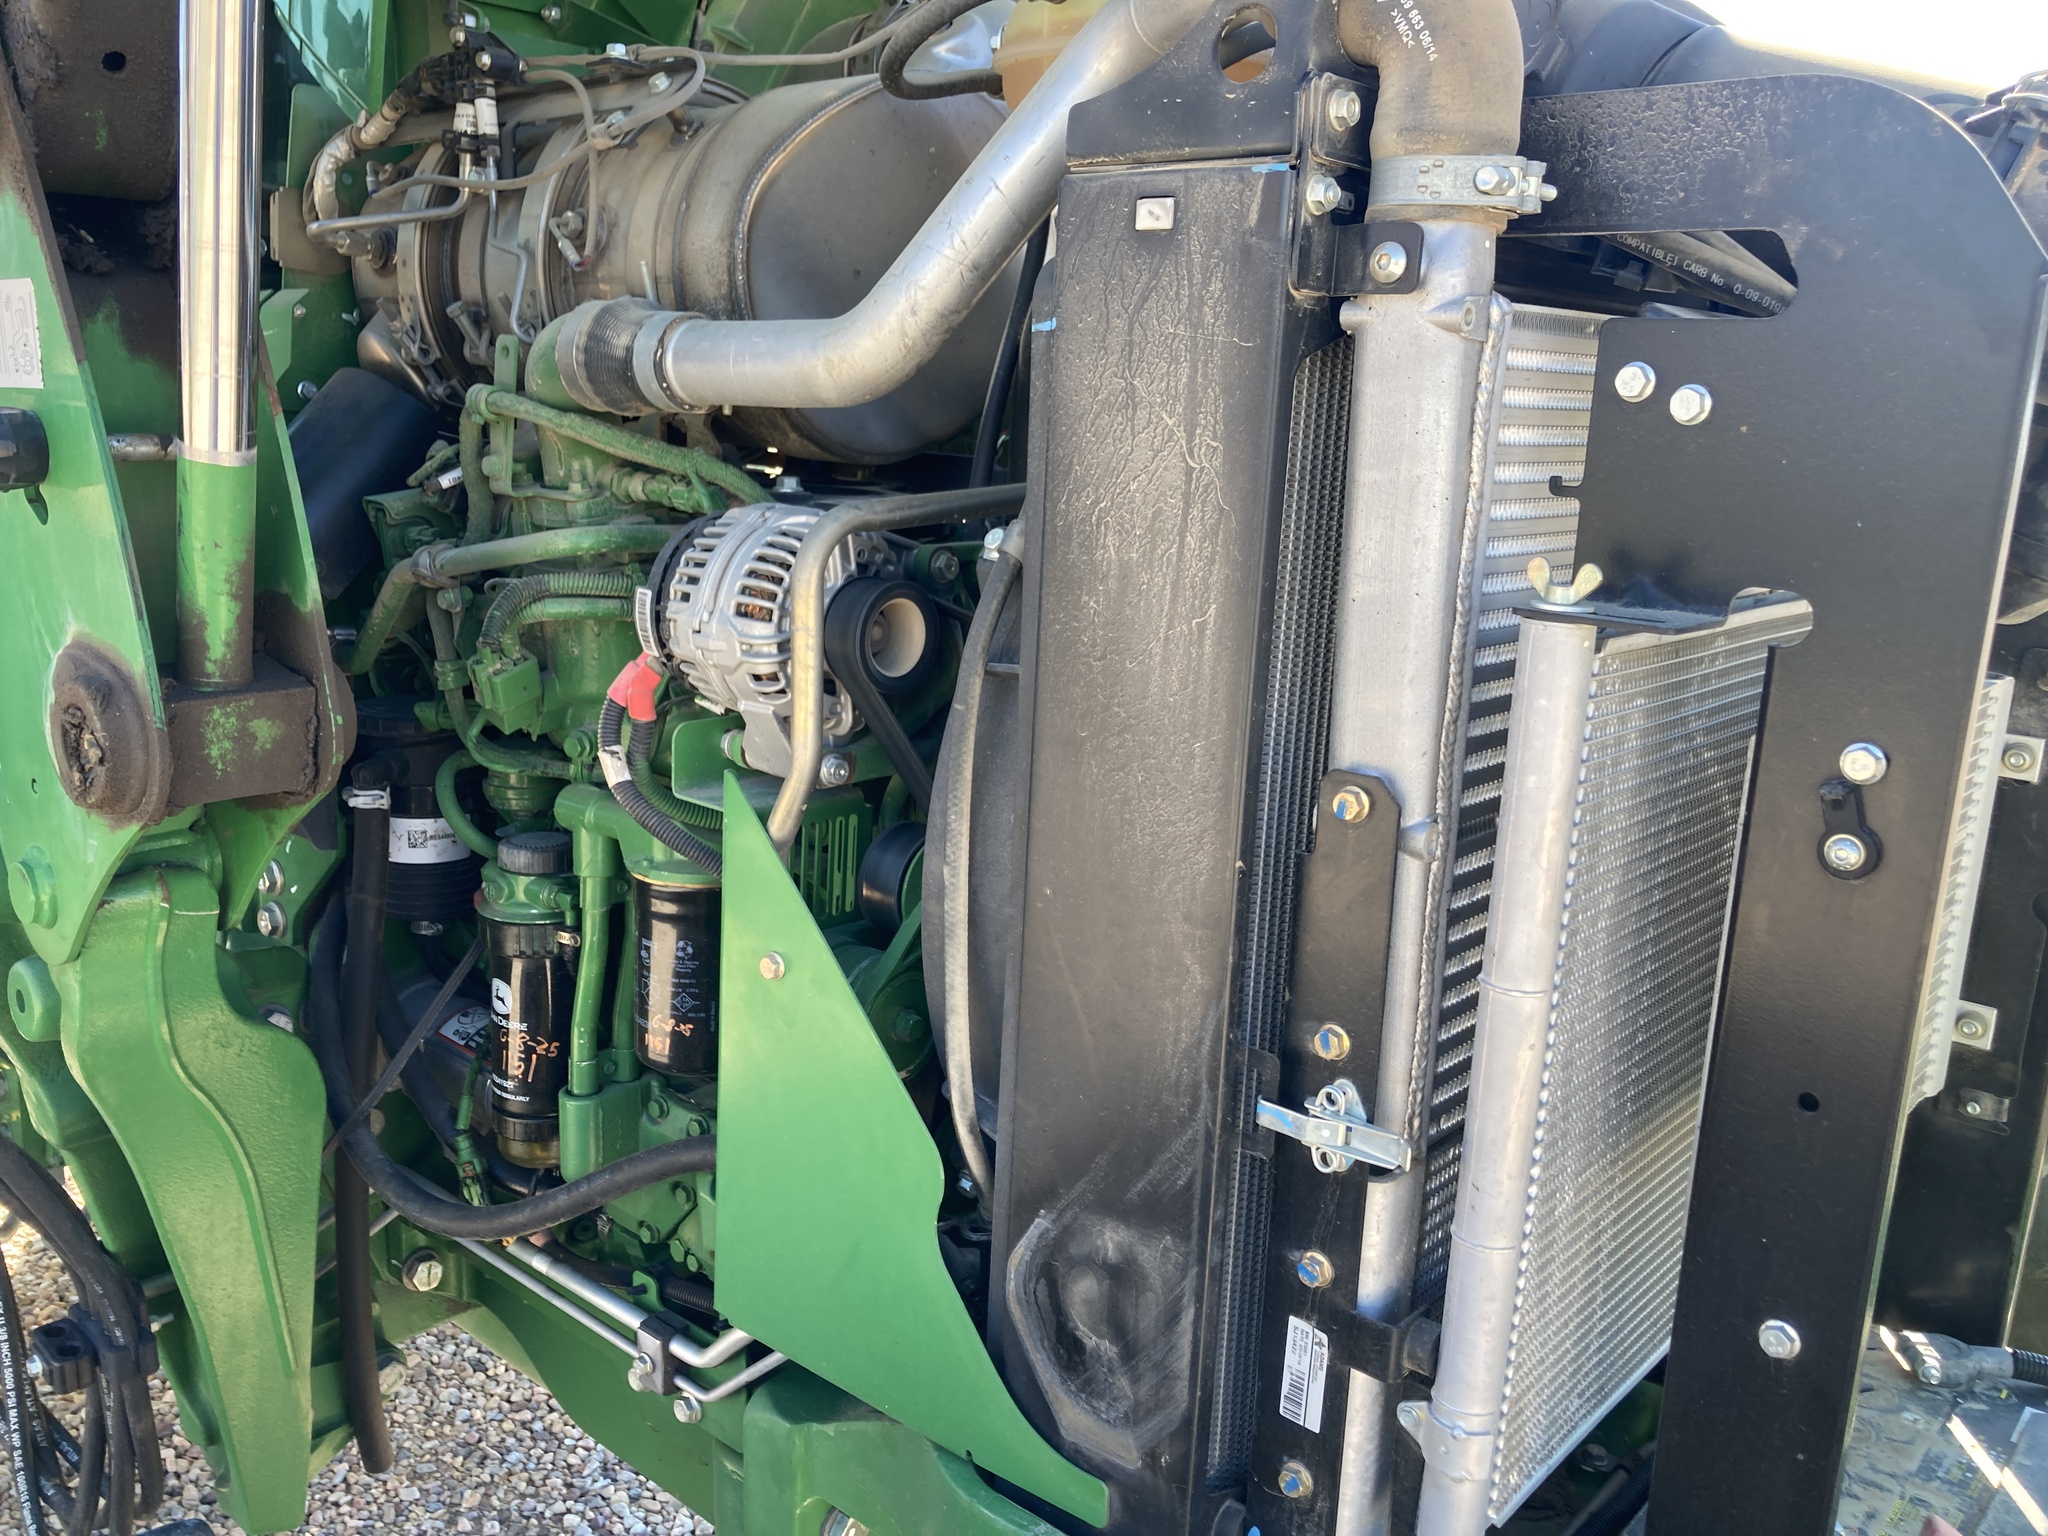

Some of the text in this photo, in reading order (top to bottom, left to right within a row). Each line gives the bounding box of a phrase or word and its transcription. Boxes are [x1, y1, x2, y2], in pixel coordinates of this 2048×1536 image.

[1390, 8, 1416, 49] >VMQ<
[1408, 9, 1425, 30] 663
[1419, 30, 1439, 62] 06/14
[1682, 259, 1709, 279] CARB
[497, 1015, 528, 1031] DEERE
[0, 1342, 12, 1366] INCH
[4, 1367, 14, 1390] 5000
[7, 1391, 17, 1408] PSI
[8, 1408, 20, 1431] MAX
[10, 1431, 21, 1448] WP
[13, 1449, 25, 1470] SAE
[16, 1470, 30, 1502] 100R16
